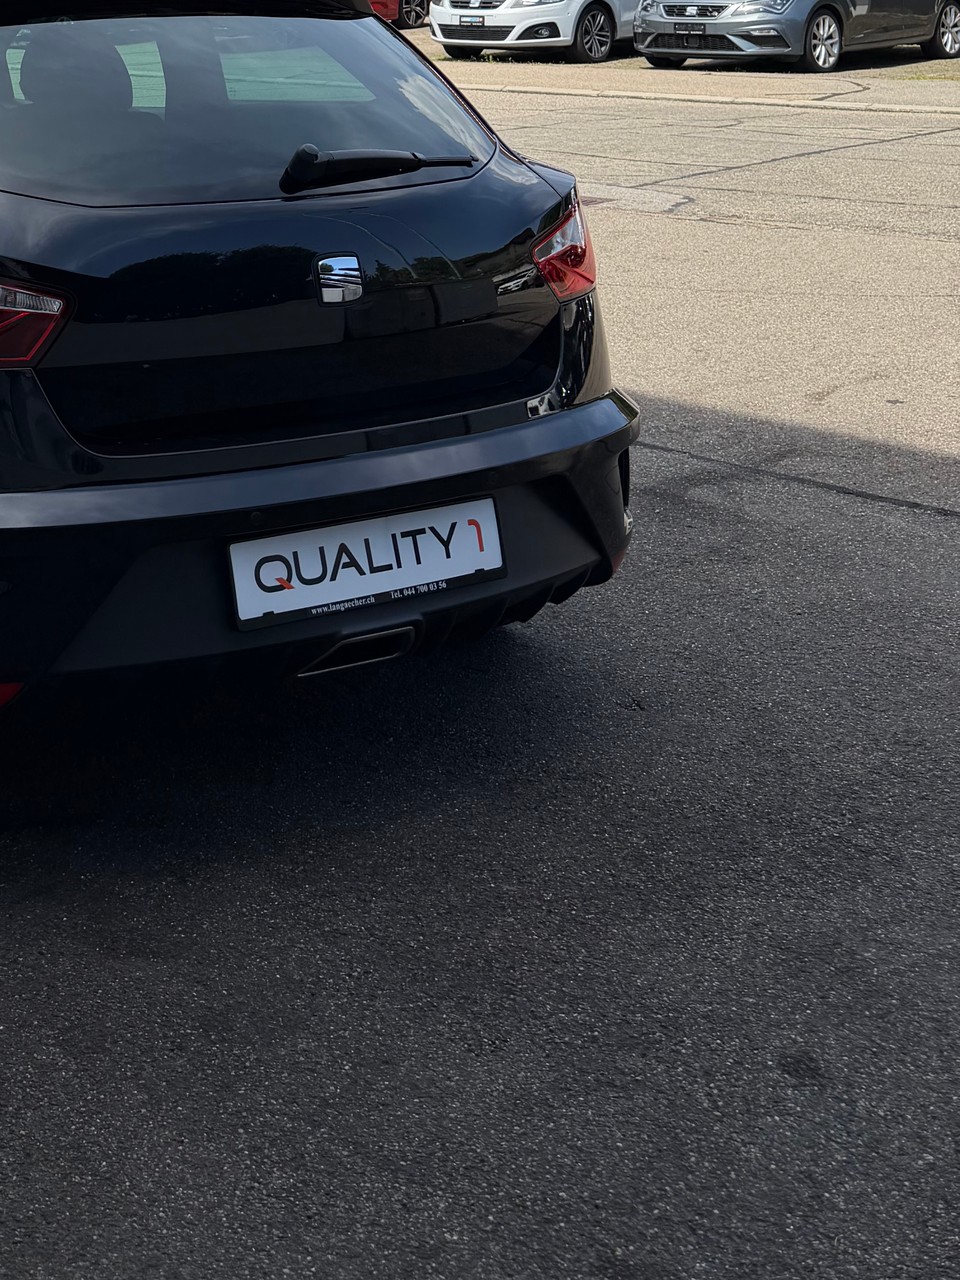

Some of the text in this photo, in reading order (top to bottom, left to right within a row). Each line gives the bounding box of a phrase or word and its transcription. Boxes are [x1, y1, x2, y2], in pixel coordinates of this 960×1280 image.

[254, 519, 485, 593] QUALITY 1
[311, 595, 376, 615] www.langaecher.ch
[390, 590, 403, 599] Tel.
[403, 587, 416, 596] 044
[416, 585, 429, 594] 700
[429, 583, 438, 591] 03
